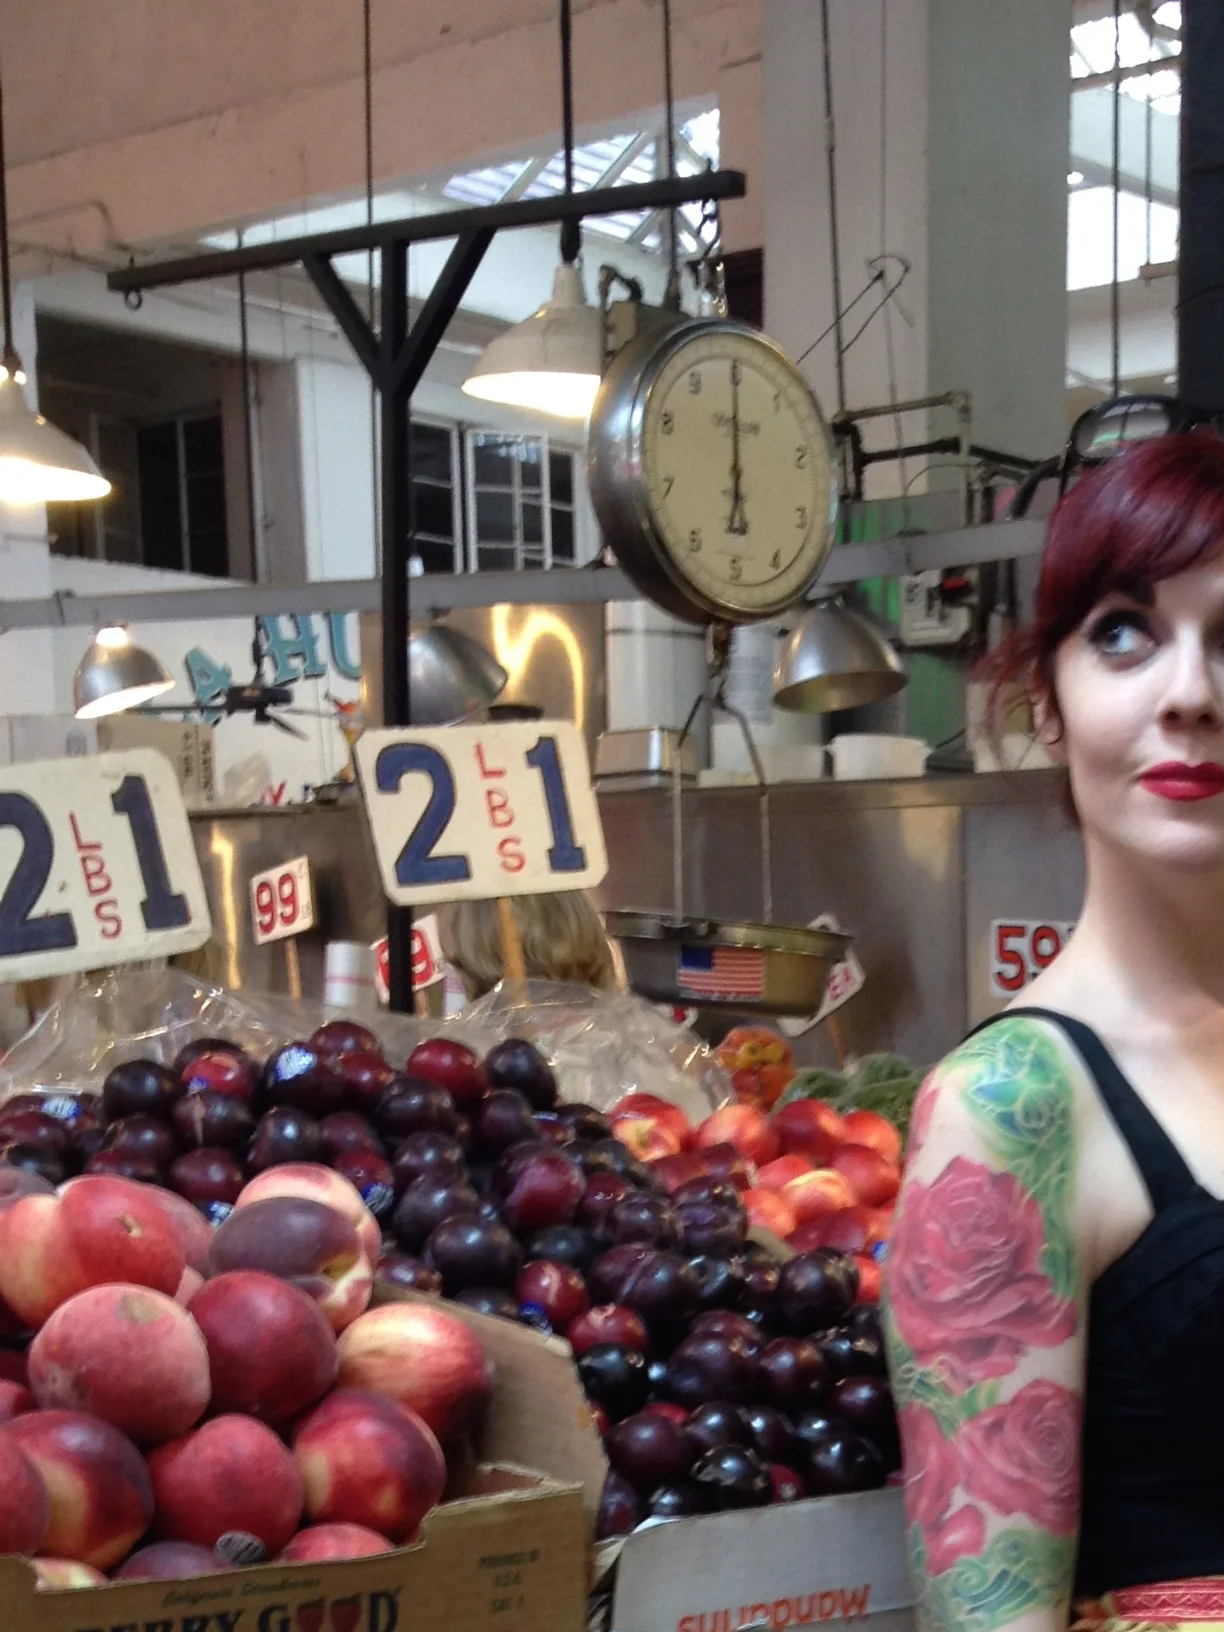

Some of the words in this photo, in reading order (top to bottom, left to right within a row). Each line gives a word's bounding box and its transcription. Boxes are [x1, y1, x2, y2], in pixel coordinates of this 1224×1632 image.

[0, 791, 78, 957] 2
[69, 811, 122, 938] LBS
[111, 775, 191, 932] 1
[375, 741, 472, 887] 2
[475, 741, 527, 874] LBS
[526, 735, 587, 872] 1
[256, 872, 299, 935] 99
